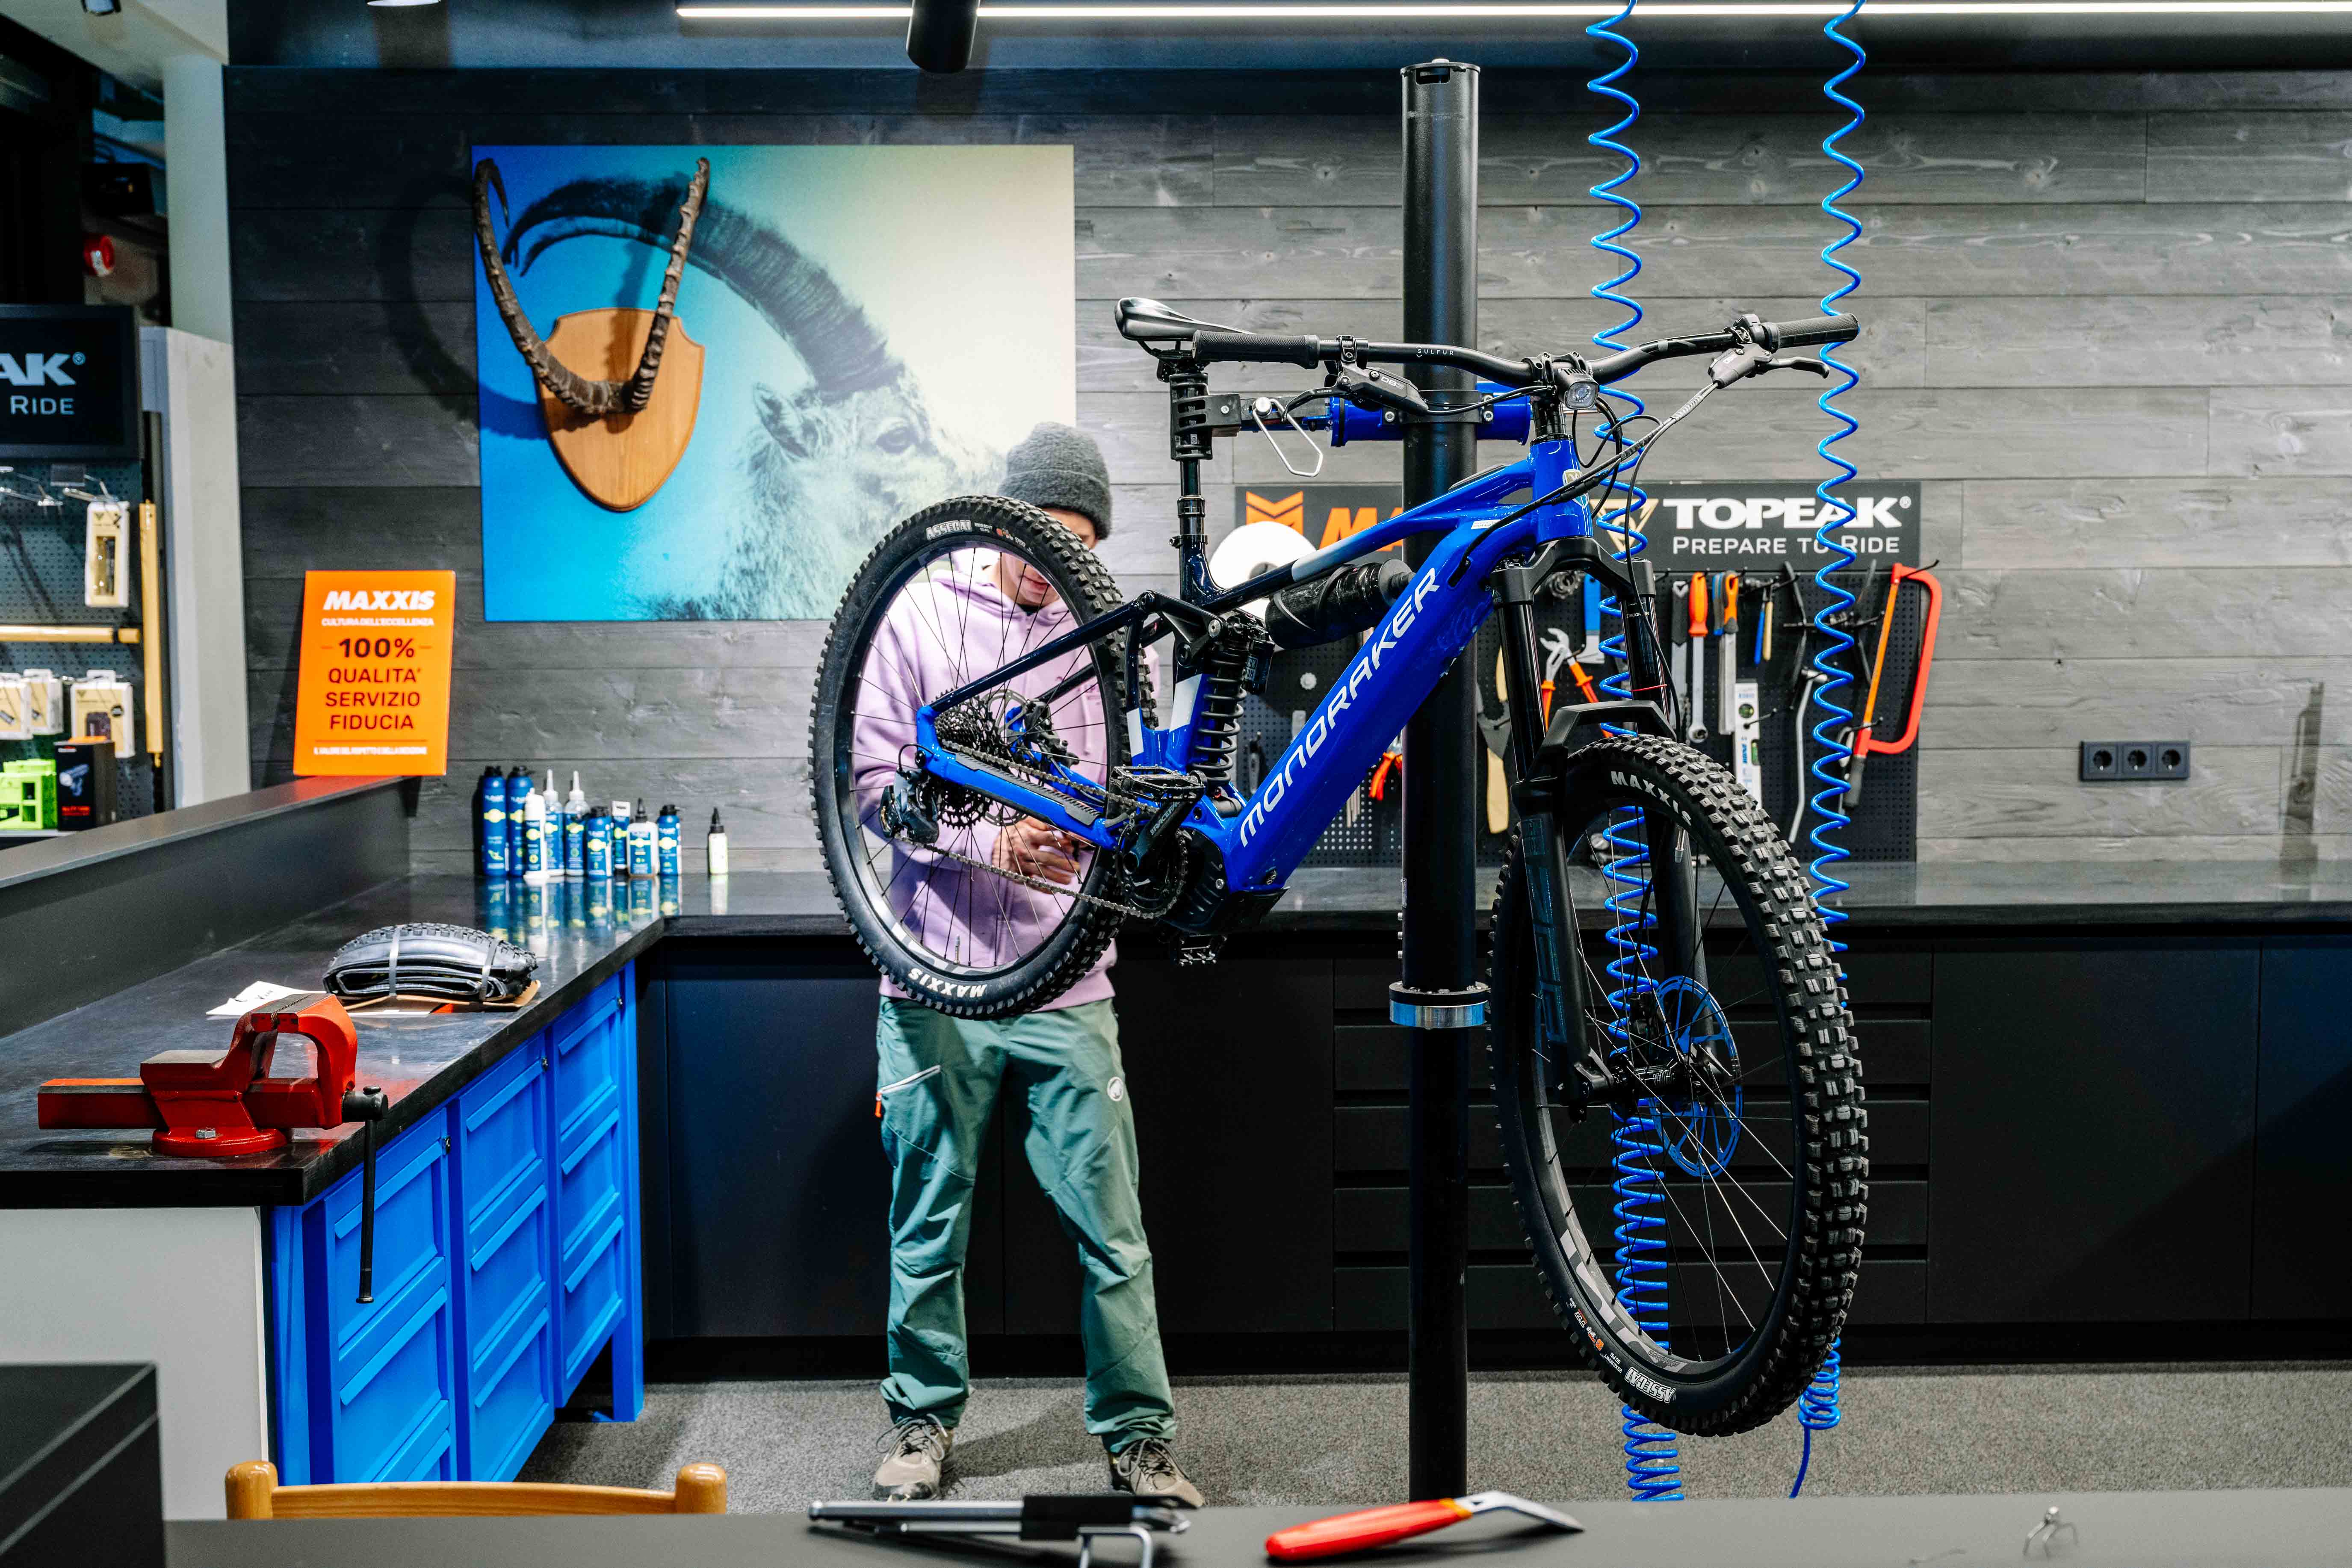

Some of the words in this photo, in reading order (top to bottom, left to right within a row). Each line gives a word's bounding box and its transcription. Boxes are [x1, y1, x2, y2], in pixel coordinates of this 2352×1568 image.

[10, 395, 75, 415] RIDE
[926, 520, 973, 541] ASSEGAI
[1672, 536, 1787, 555] PREPARE
[1841, 535, 1900, 554] RIDE
[322, 590, 436, 611] MAXXIS
[339, 638, 415, 658] 100%
[325, 692, 420, 707] SERVIZIO
[1241, 567, 1440, 847] MONDRAKER
[330, 715, 414, 729] FIDUCIA
[1610, 771, 1692, 826] MAXXIS
[907, 967, 988, 998] MAXXIS
[1625, 1366, 1676, 1404] ASSEGAI
